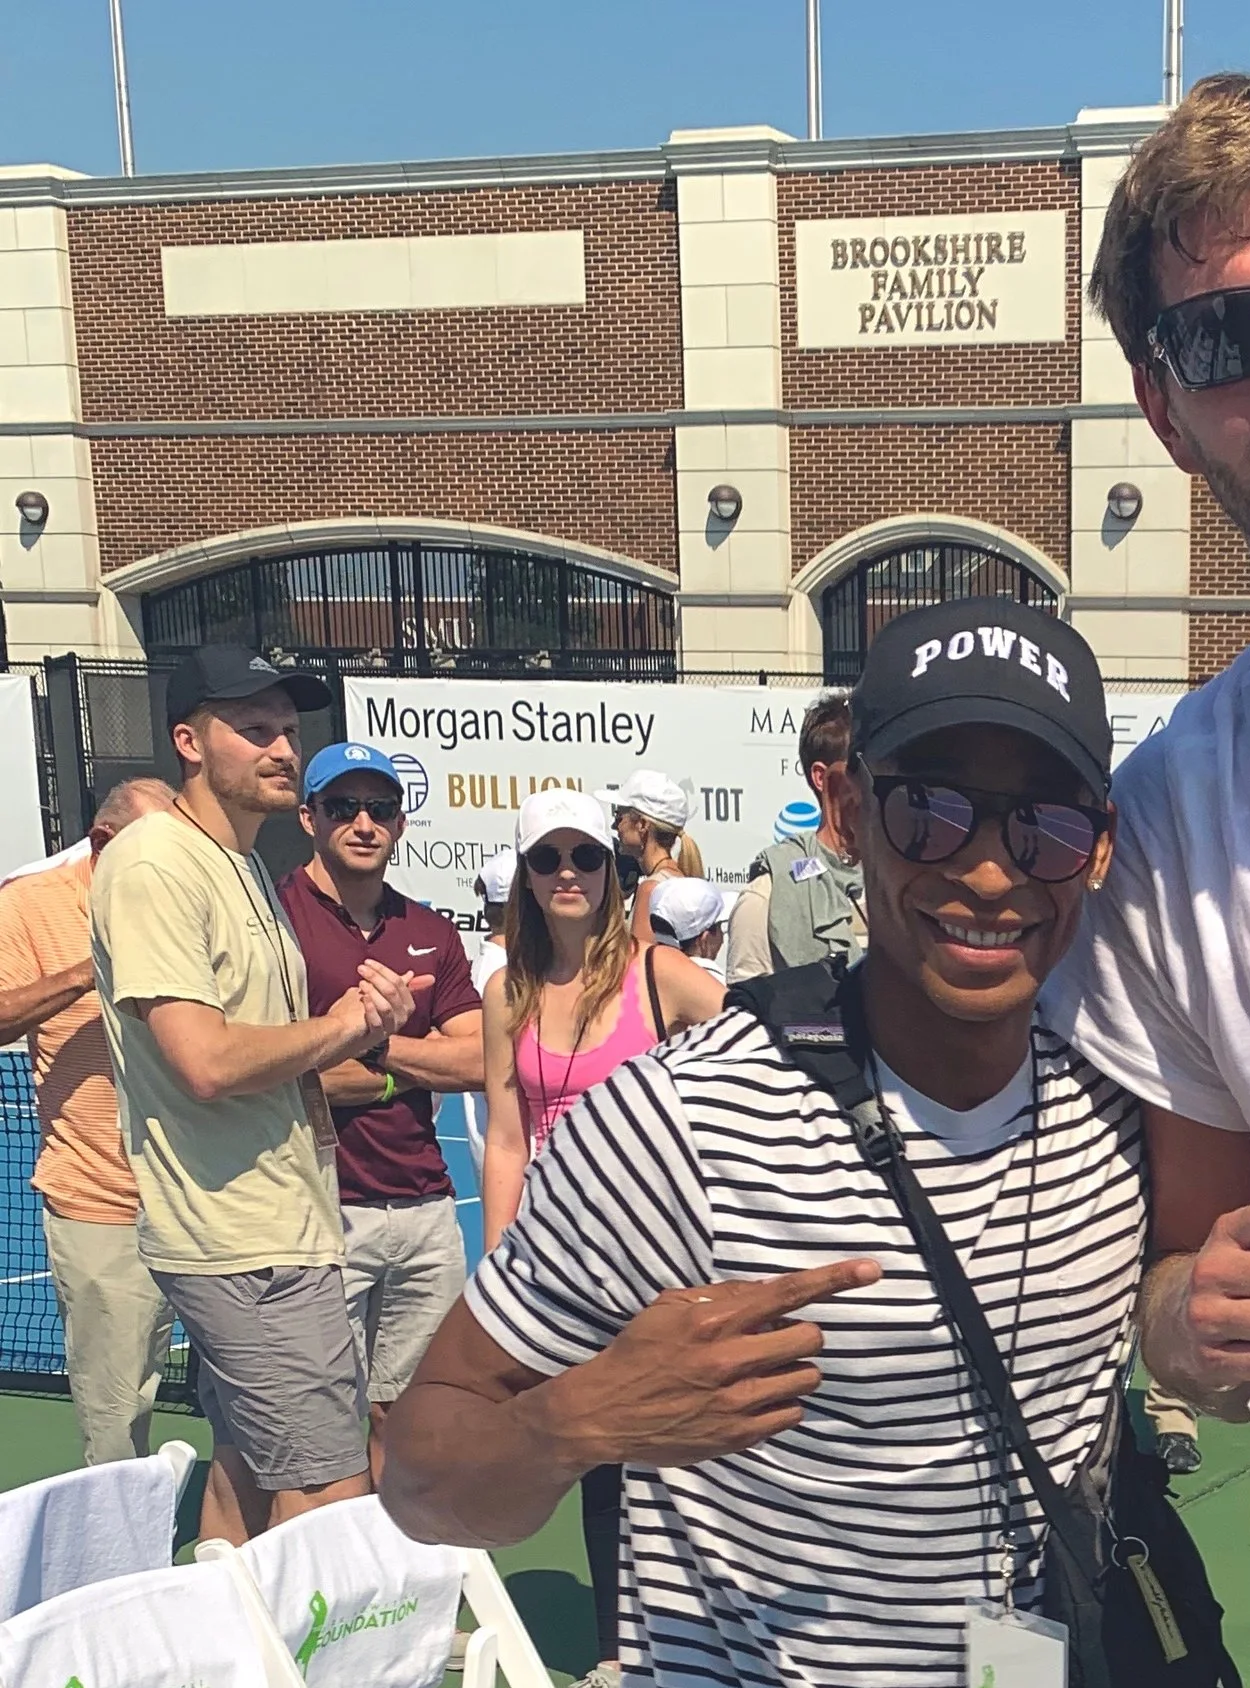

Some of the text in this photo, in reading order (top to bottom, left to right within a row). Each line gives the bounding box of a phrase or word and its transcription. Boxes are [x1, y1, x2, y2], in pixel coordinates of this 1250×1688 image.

[831, 231, 1027, 270] BROOKSHIRE
[870, 267, 985, 301] FAMILY
[858, 299, 998, 334] PAVILION
[401, 617, 475, 650] SMU
[911, 626, 1071, 703] POWER
[365, 697, 655, 756] Morgan Stanley
[750, 706, 798, 734] MA
[700, 787, 744, 822] TOT
[405, 819, 432, 828] PORT
[405, 840, 512, 870] NORTH
[456, 877, 474, 888] THE
